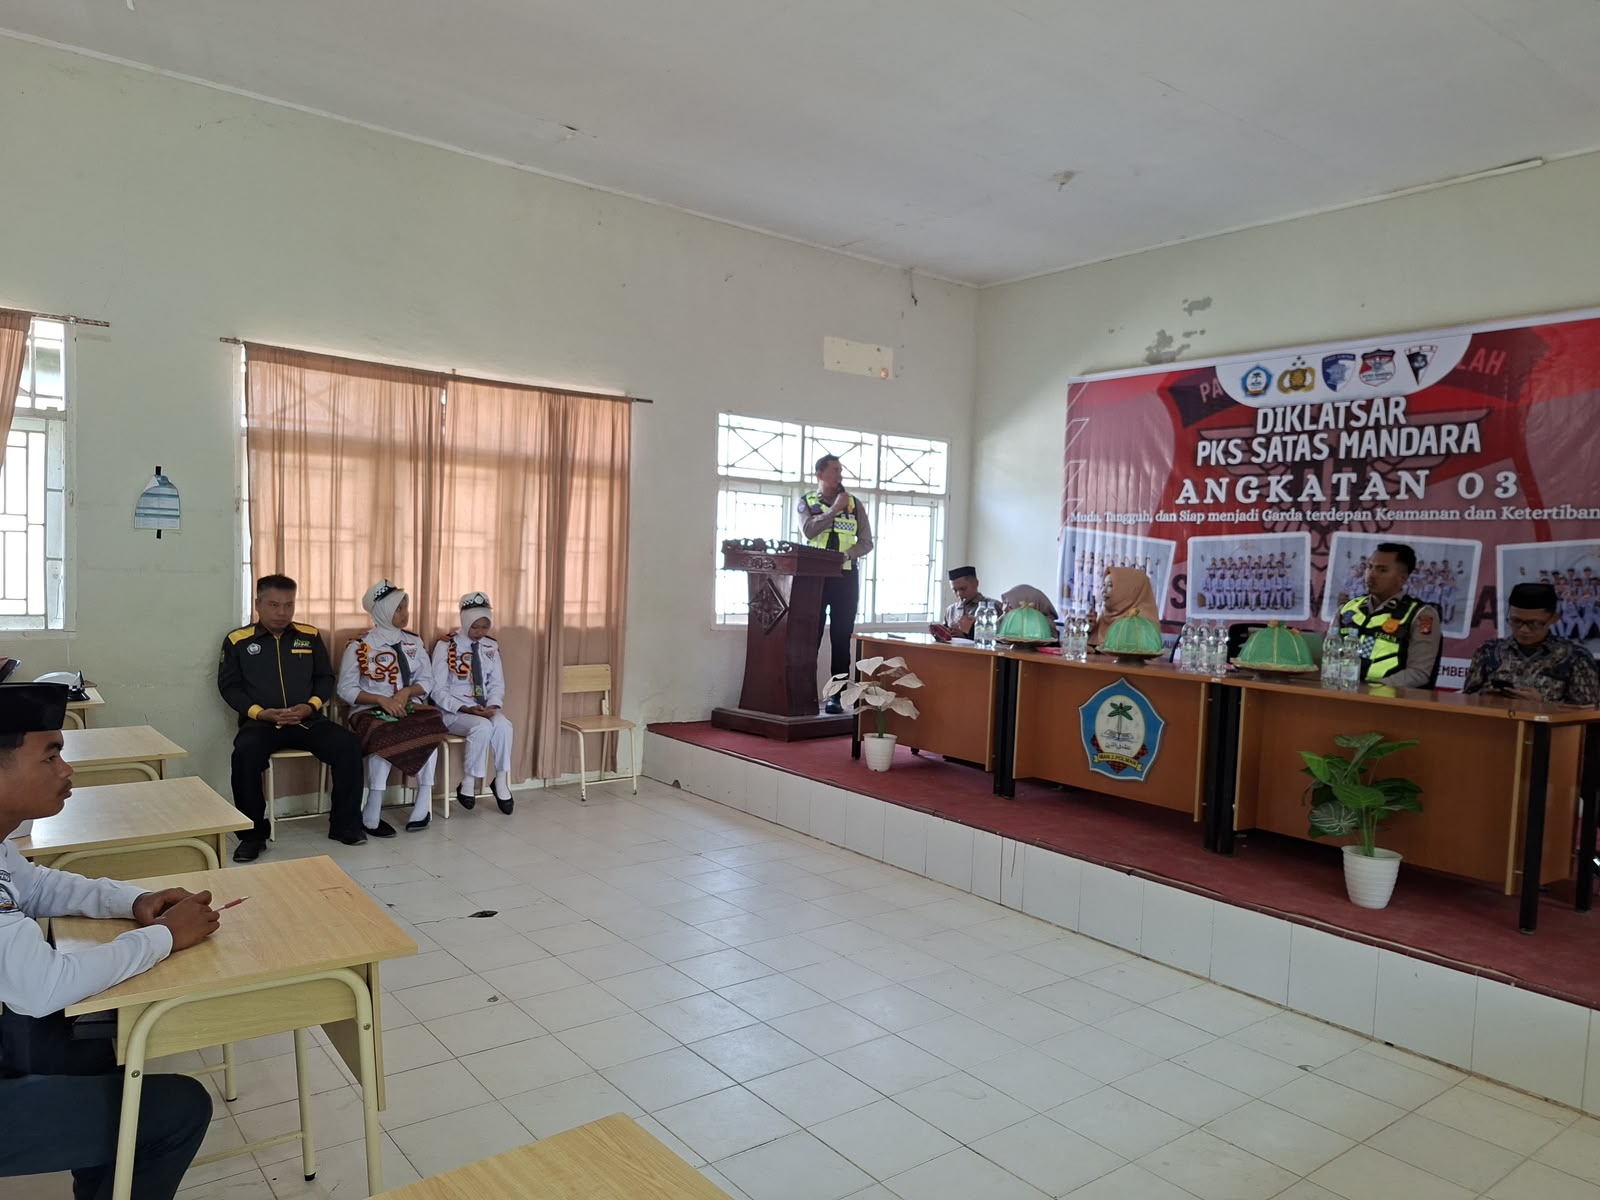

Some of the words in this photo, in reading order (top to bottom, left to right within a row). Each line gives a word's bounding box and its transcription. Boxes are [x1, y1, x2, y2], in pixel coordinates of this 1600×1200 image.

[1256, 397, 1407, 435] DIKLATSAR
[1196, 438, 1243, 467] PKS
[1251, 433, 1330, 462] SATAS
[1339, 422, 1482, 460] MANDARA
[1175, 470, 1430, 505] ANGKATAN
[1070, 511, 1101, 523] Muda,
[1104, 510, 1153, 526] Tangguh,
[1155, 509, 1177, 522] dan
[1179, 510, 1204, 525] Siap
[1208, 508, 1259, 525] menjadi
[1262, 509, 1302, 523] Garda
[1306, 508, 1371, 525] terdepan
[1375, 506, 1461, 522] Keamanan
[1464, 504, 1497, 521] dan
[1500, 503, 1600, 521] Ketertiban
